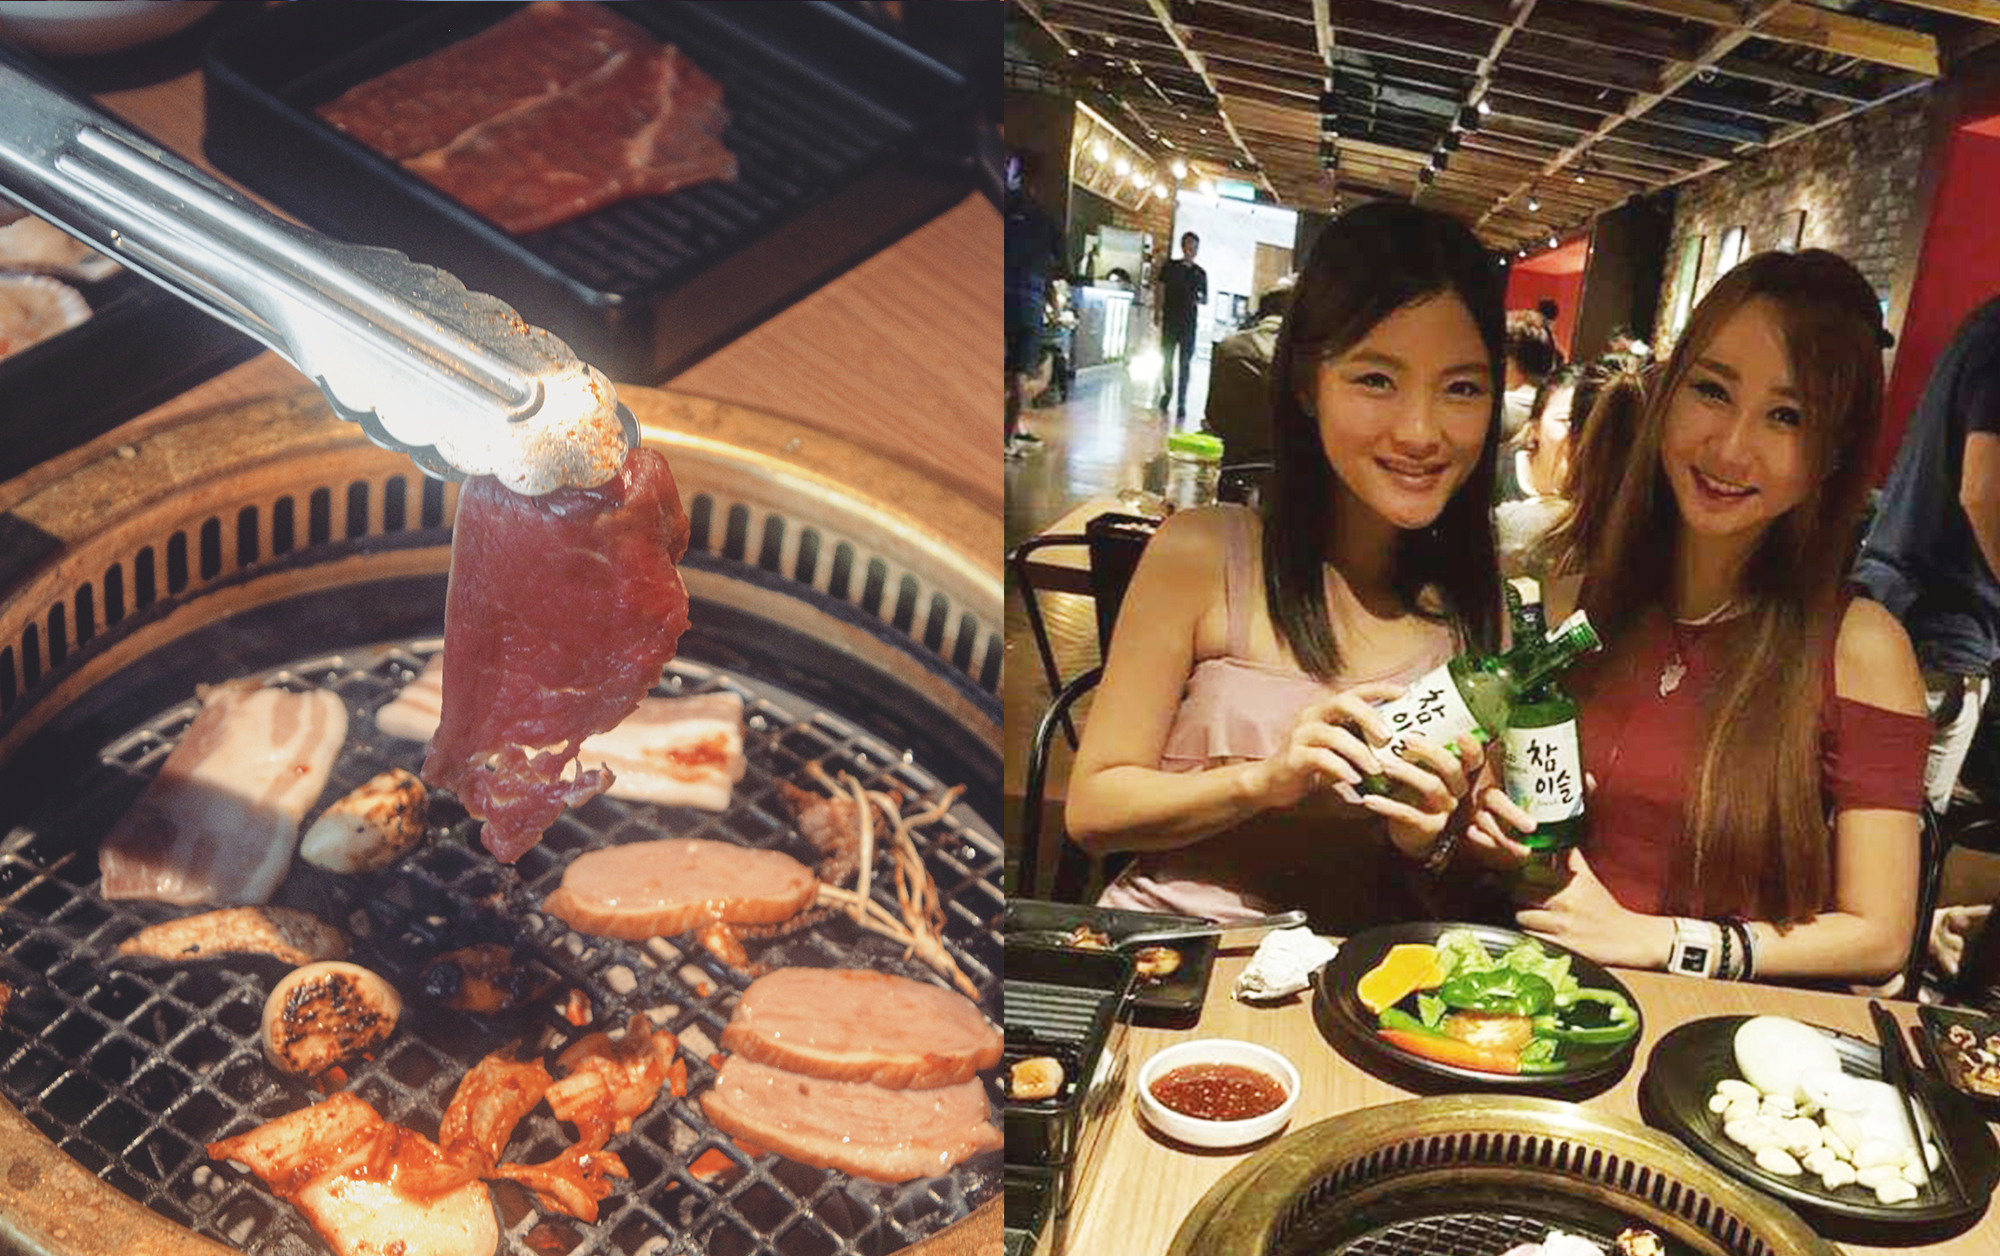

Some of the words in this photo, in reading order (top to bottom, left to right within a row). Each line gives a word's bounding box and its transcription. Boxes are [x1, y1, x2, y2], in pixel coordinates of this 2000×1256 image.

[1416, 689, 1445, 725] 참
[1527, 738, 1558, 773] 참
[1535, 769, 1574, 804] 이슬
